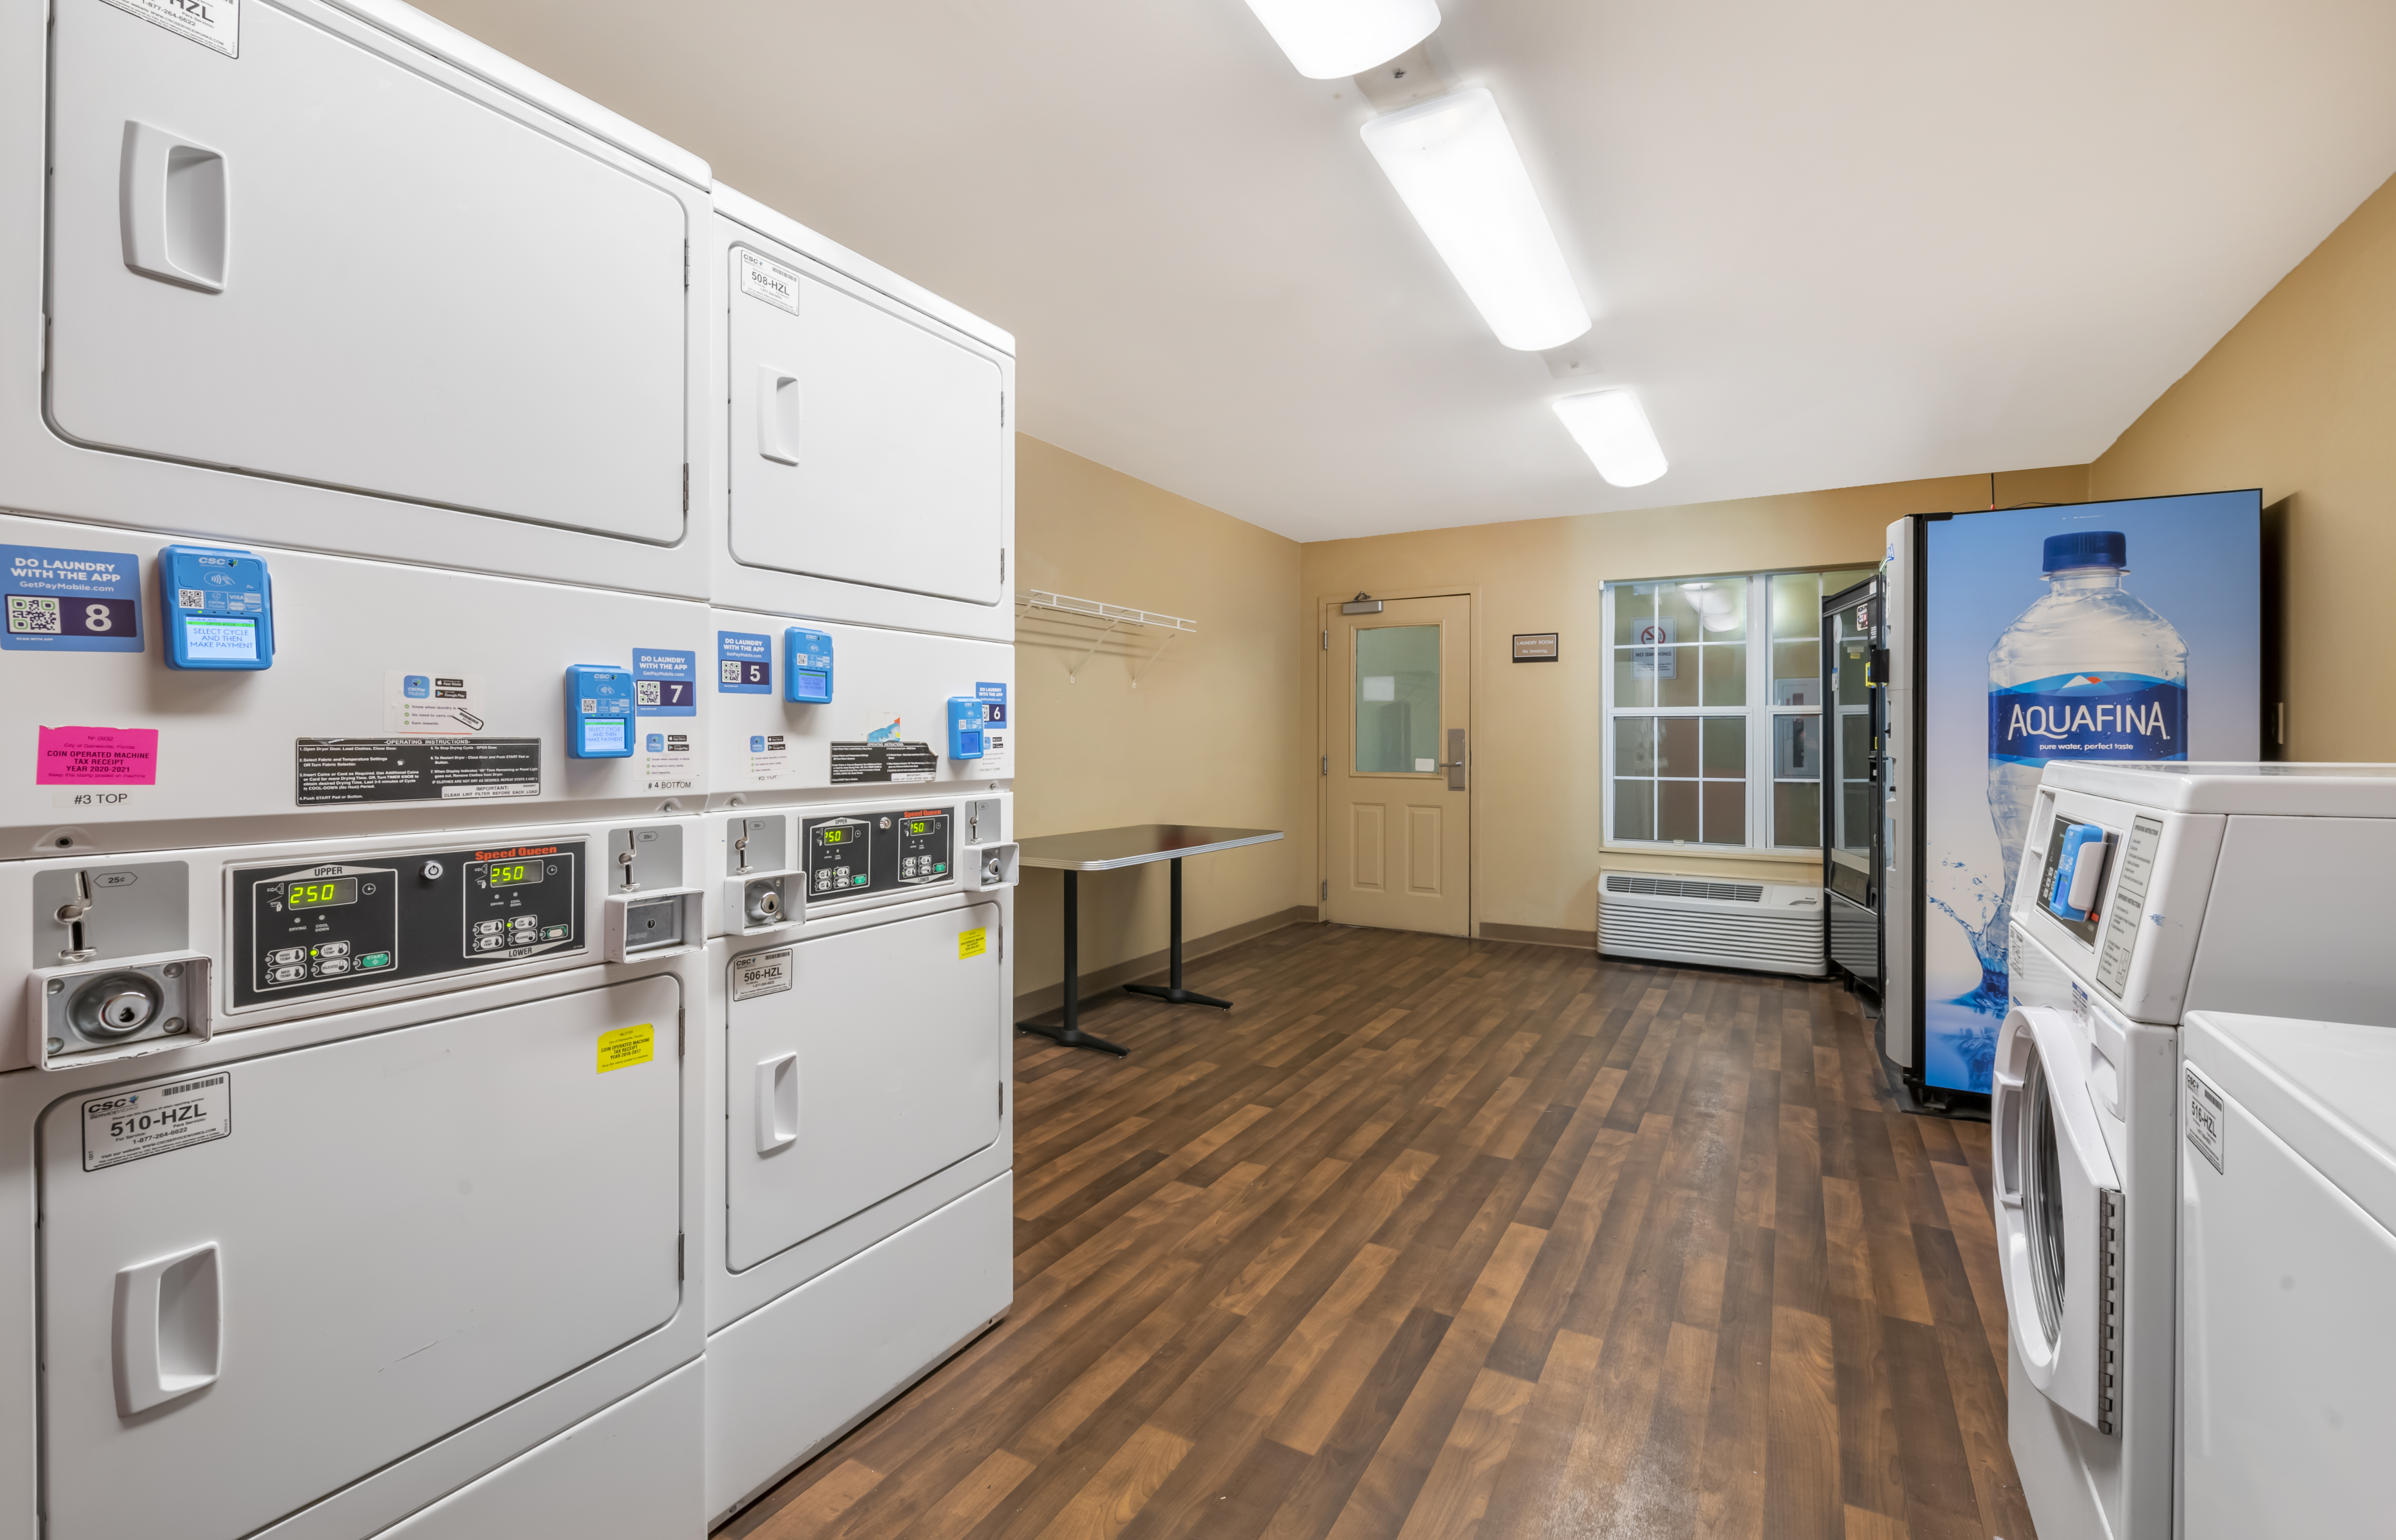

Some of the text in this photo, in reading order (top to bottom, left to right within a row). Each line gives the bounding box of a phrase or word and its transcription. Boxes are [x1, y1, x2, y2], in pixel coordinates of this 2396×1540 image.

[743, 254, 758, 264] CSC
[751, 271, 790, 296] 508-HZL
[15, 558, 115, 572] DO LAUNDRY
[10, 568, 121, 582] WITH THE APP
[20, 581, 114, 592] GetPayMobile.com
[86, 604, 112, 632] 8
[750, 666, 760, 681] 5
[671, 685, 683, 703] 7
[993, 706, 1001, 720] 6
[2008, 702, 2167, 741] AQUAFINA
[2085, 743, 2112, 751] perfect
[74, 794, 127, 805] #3 TOP
[475, 847, 557, 861] Speed Queen
[314, 867, 342, 876] UPPER
[290, 884, 334, 904] 250
[509, 948, 532, 957] LOWER
[744, 967, 782, 982] 506-HZL
[621, 1049, 641, 1057] 2016-2017
[2187, 1075, 2196, 1088] CSC
[88, 1099, 127, 1113] CSC
[111, 1104, 207, 1136] 510-HZL
[2192, 1101, 2216, 1138] 516-HZL
[133, 1127, 188, 1144] 1-877-264-6622
